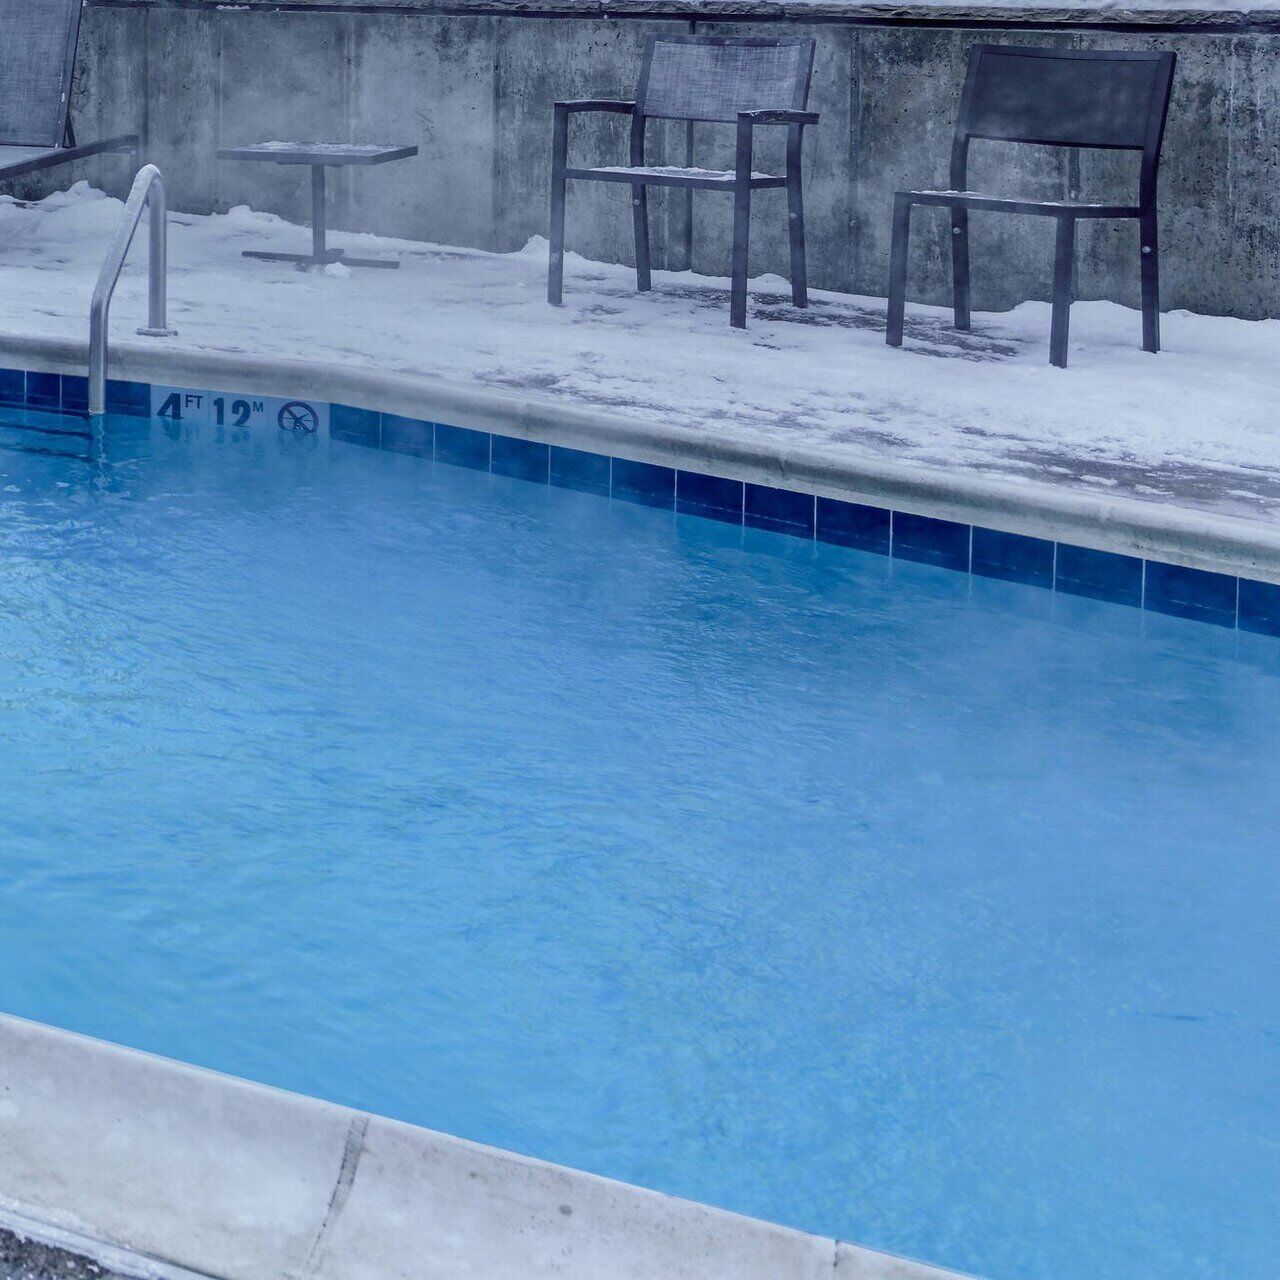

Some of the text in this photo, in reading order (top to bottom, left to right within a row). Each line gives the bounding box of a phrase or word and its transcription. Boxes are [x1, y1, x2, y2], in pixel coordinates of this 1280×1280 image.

[156, 392, 184, 420] 4
[185, 394, 203, 410] FT
[252, 401, 264, 413] M
